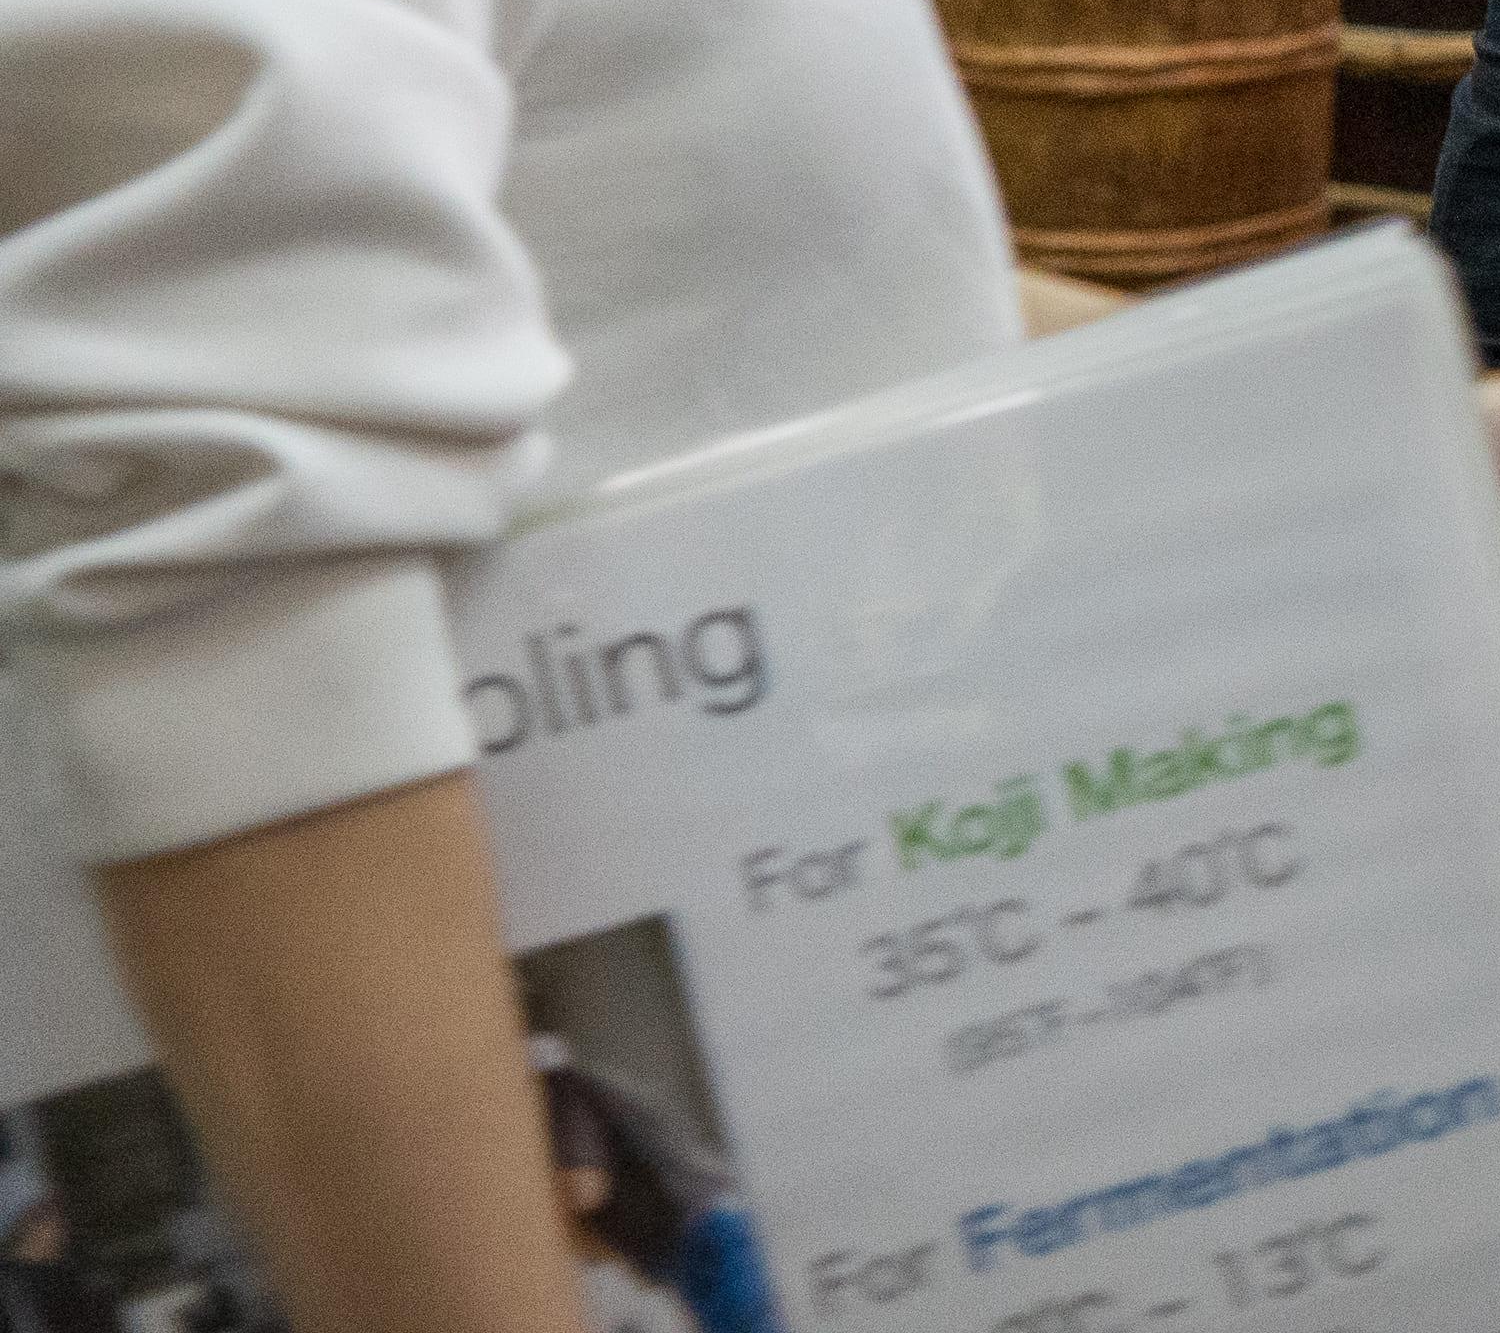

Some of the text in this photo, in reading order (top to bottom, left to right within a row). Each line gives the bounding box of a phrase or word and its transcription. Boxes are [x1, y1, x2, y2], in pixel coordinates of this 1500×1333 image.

[461, 601, 766, 756] oling
[739, 700, 1361, 915] For Koji Making
[809, 1241, 936, 1317] For
